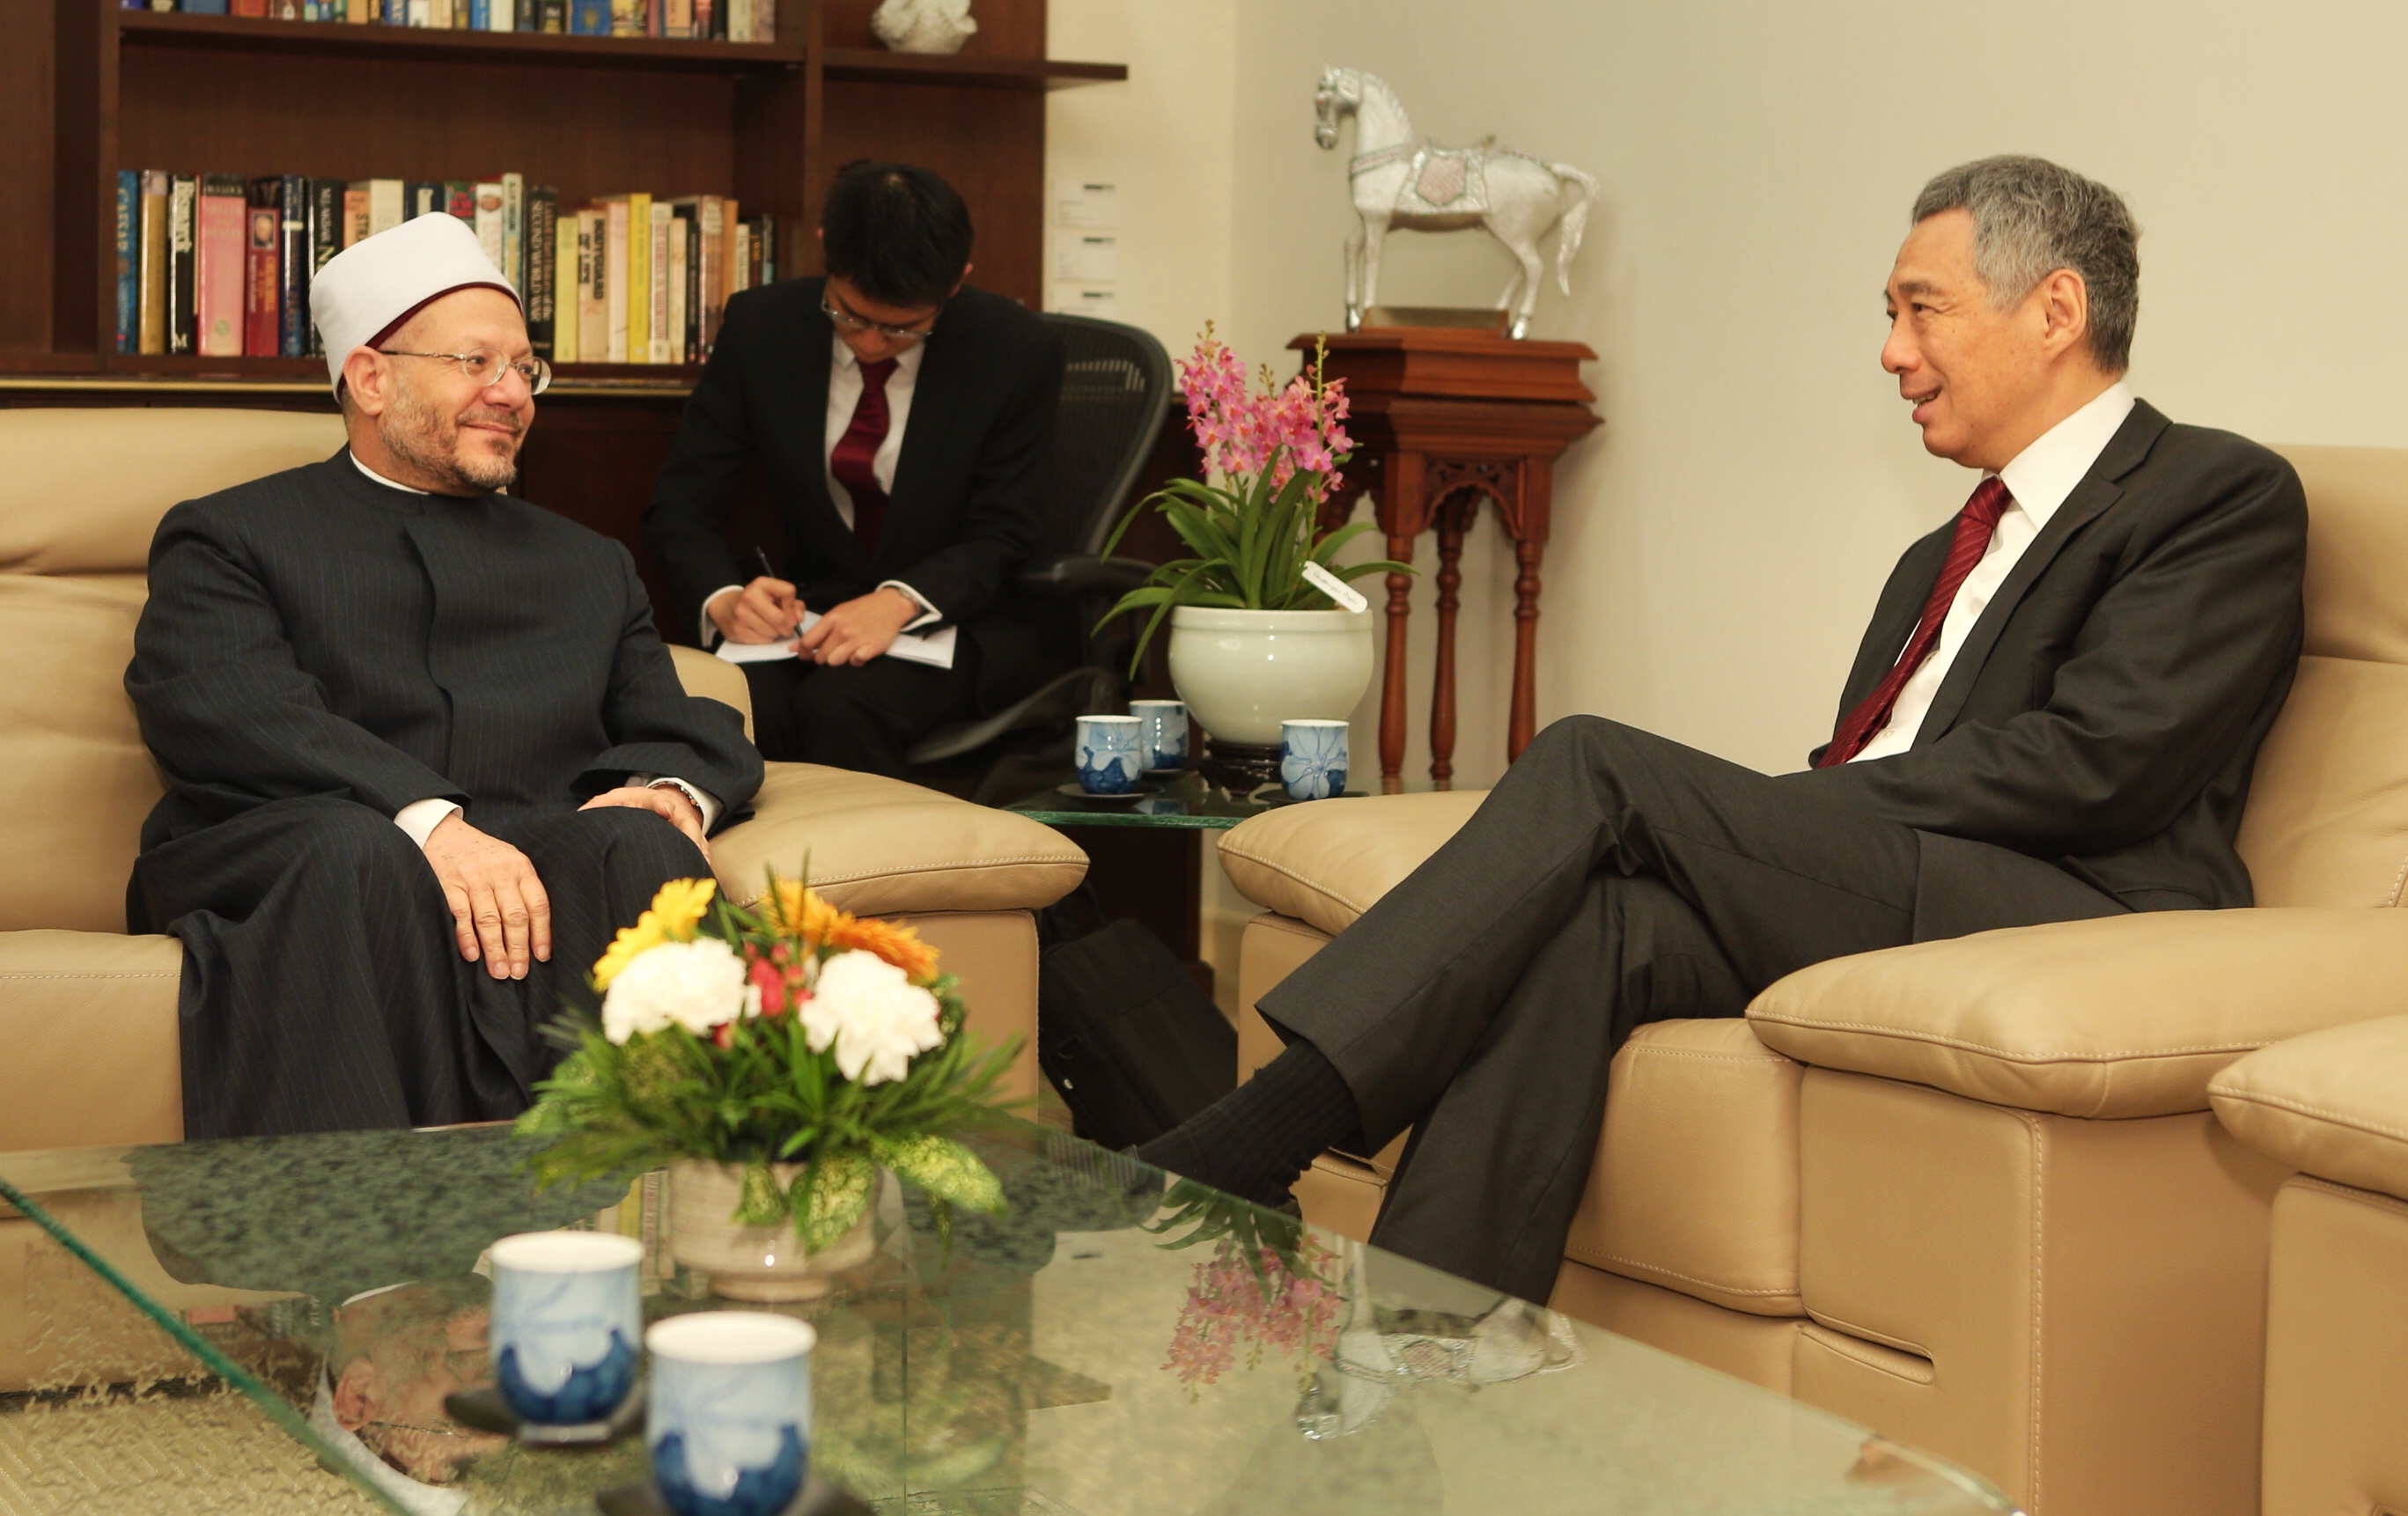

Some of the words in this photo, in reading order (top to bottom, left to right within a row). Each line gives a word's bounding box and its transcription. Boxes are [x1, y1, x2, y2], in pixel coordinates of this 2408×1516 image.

[116, 188, 129, 252] CAESAR
[532, 200, 542, 249] SECOND
[531, 251, 541, 294] WORLD
[593, 217, 605, 300] BODYGUARD
[529, 295, 541, 322] WAR
[542, 305, 552, 321] the
